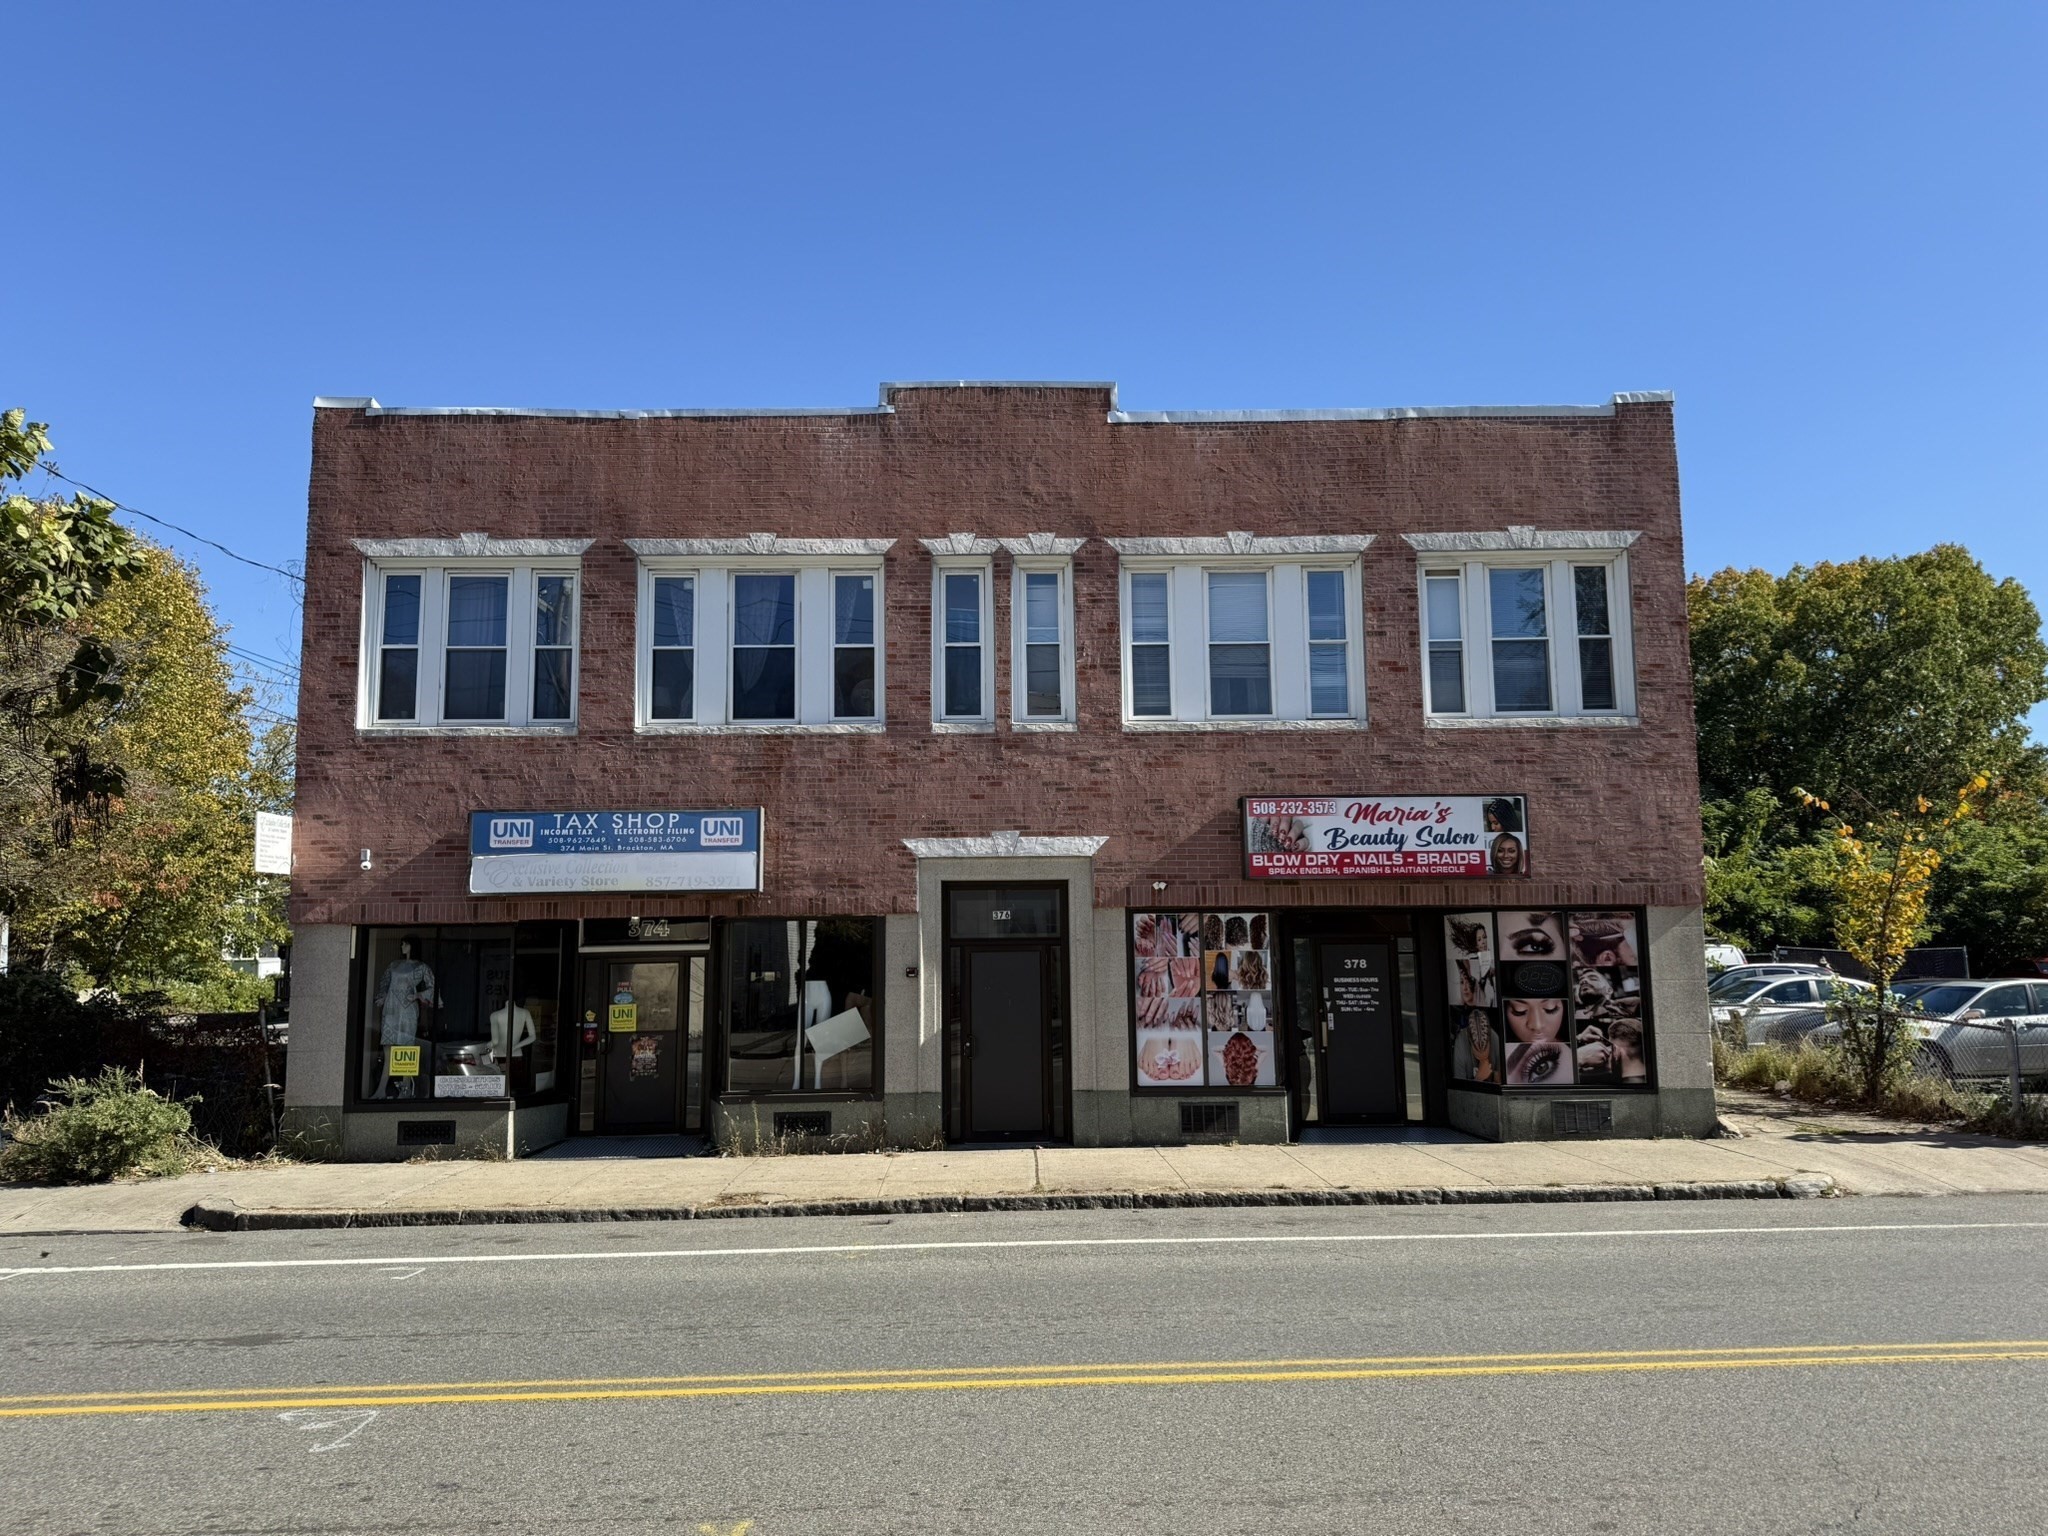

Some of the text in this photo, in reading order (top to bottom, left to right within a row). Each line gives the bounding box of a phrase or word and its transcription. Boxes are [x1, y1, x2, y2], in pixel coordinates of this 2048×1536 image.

[1252, 801, 1337, 815] 508-232-3573
[1344, 801, 1453, 826] Maria's
[553, 813, 680, 829] TAX SHOP
[703, 820, 741, 836] UNI
[493, 821, 531, 838] UNI
[540, 828, 574, 836] INCOME
[577, 828, 593, 836] TAX
[667, 827, 695, 835] FILING
[1323, 827, 1408, 852] Beauty
[1415, 825, 1479, 848] Salon
[617, 844, 656, 852] Brockton,
[1252, 854, 1302, 867] BLOW
[1305, 854, 1340, 866] DRY
[1354, 853, 1403, 866] NAILS
[1417, 852, 1481, 865] BRAIDS
[483, 860, 561, 888] Exclusive
[565, 858, 629, 874] Collection
[1268, 865, 1466, 876] SPEAK ENGLISH, SPANISH & HAITIAN CREOLE
[512, 875, 741, 888] & Variety Store 857-719-3971
[994, 911, 1010, 919] 376
[628, 919, 671, 937] 374
[1344, 959, 1367, 969] 378
[1519, 970, 1561, 985] OPEN
[613, 1009, 632, 1019] UNI
[394, 1050, 416, 1062] UNI
